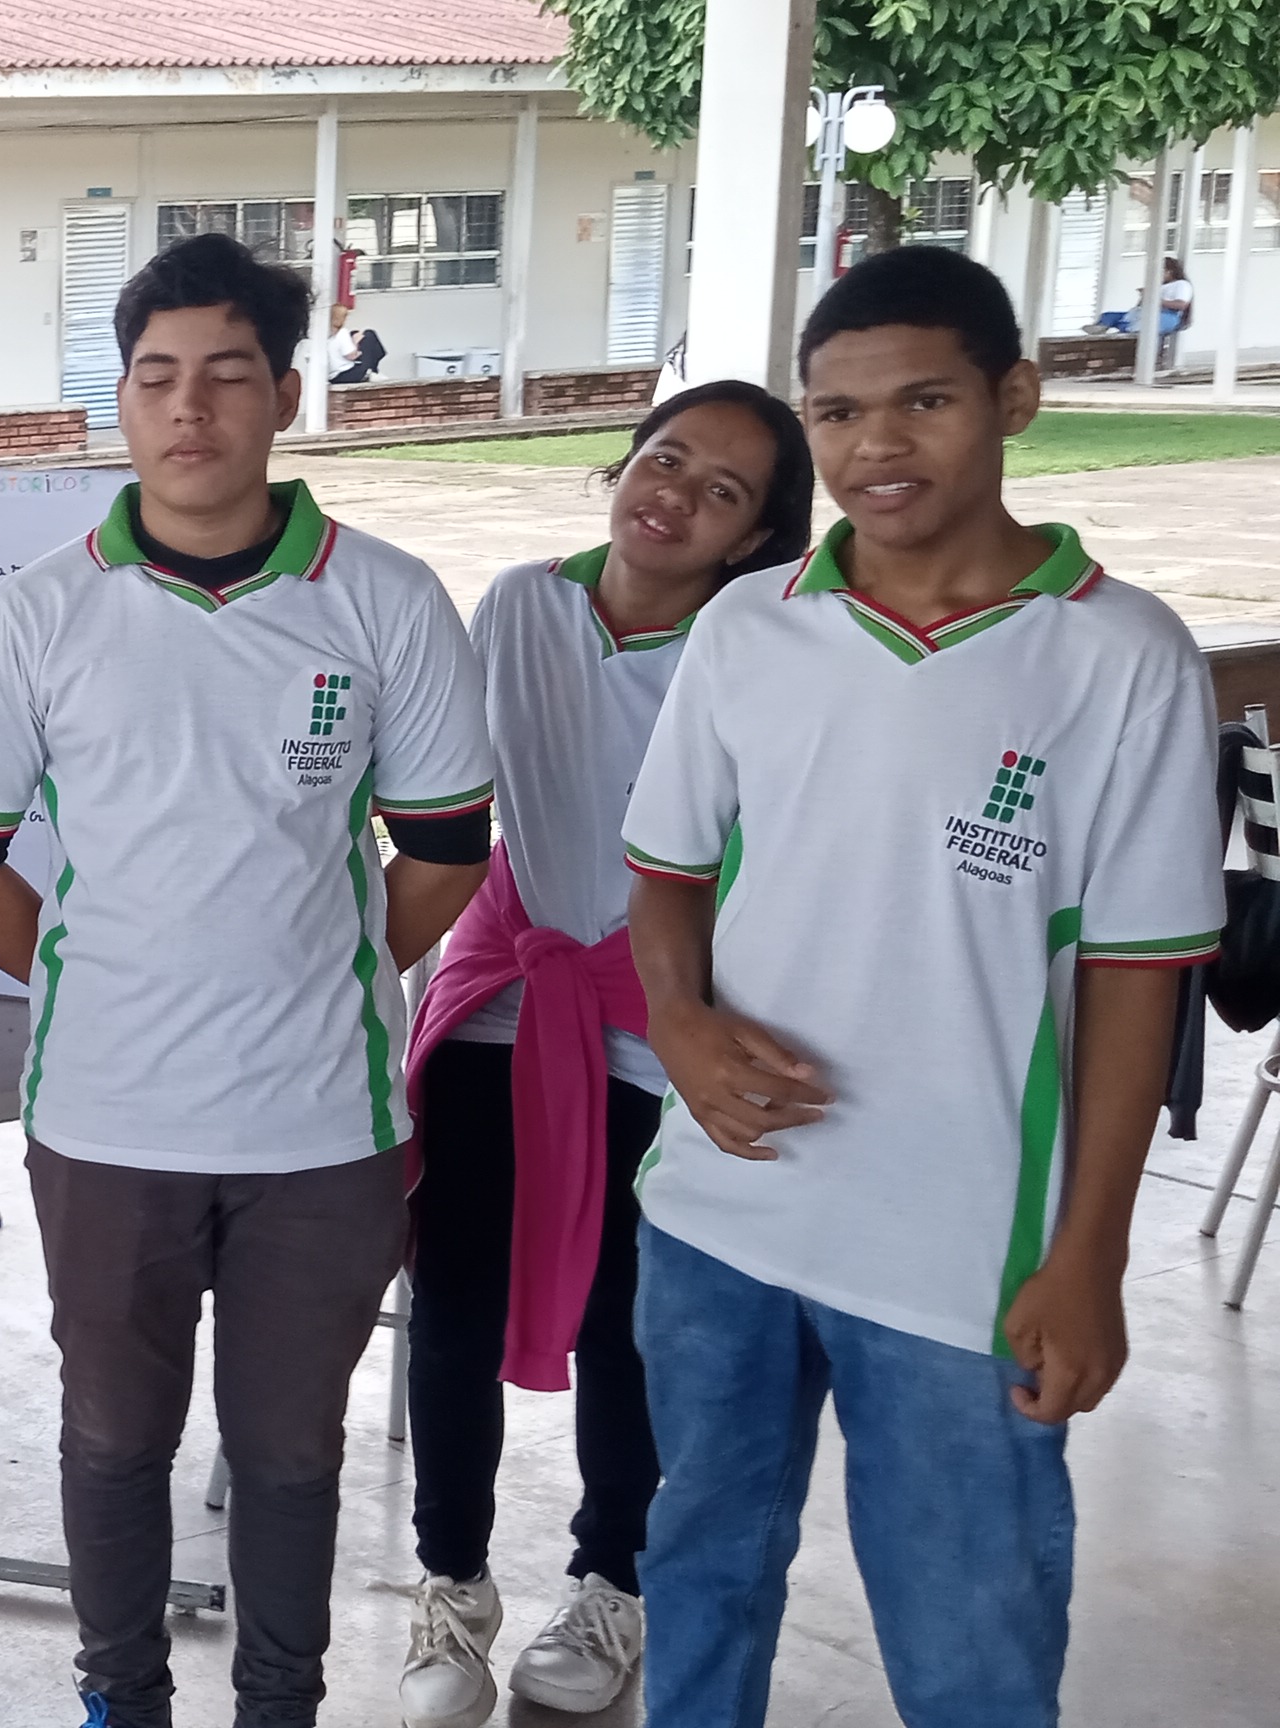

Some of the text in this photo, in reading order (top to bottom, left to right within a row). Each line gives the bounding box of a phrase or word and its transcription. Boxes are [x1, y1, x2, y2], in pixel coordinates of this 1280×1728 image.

[288, 756, 342, 770] FEDERAL
[297, 773, 332, 788] Alagoas
[945, 815, 1048, 858] INSTITUTO
[946, 834, 1033, 872] FEDERAL
[956, 859, 1013, 885] Alagoas
